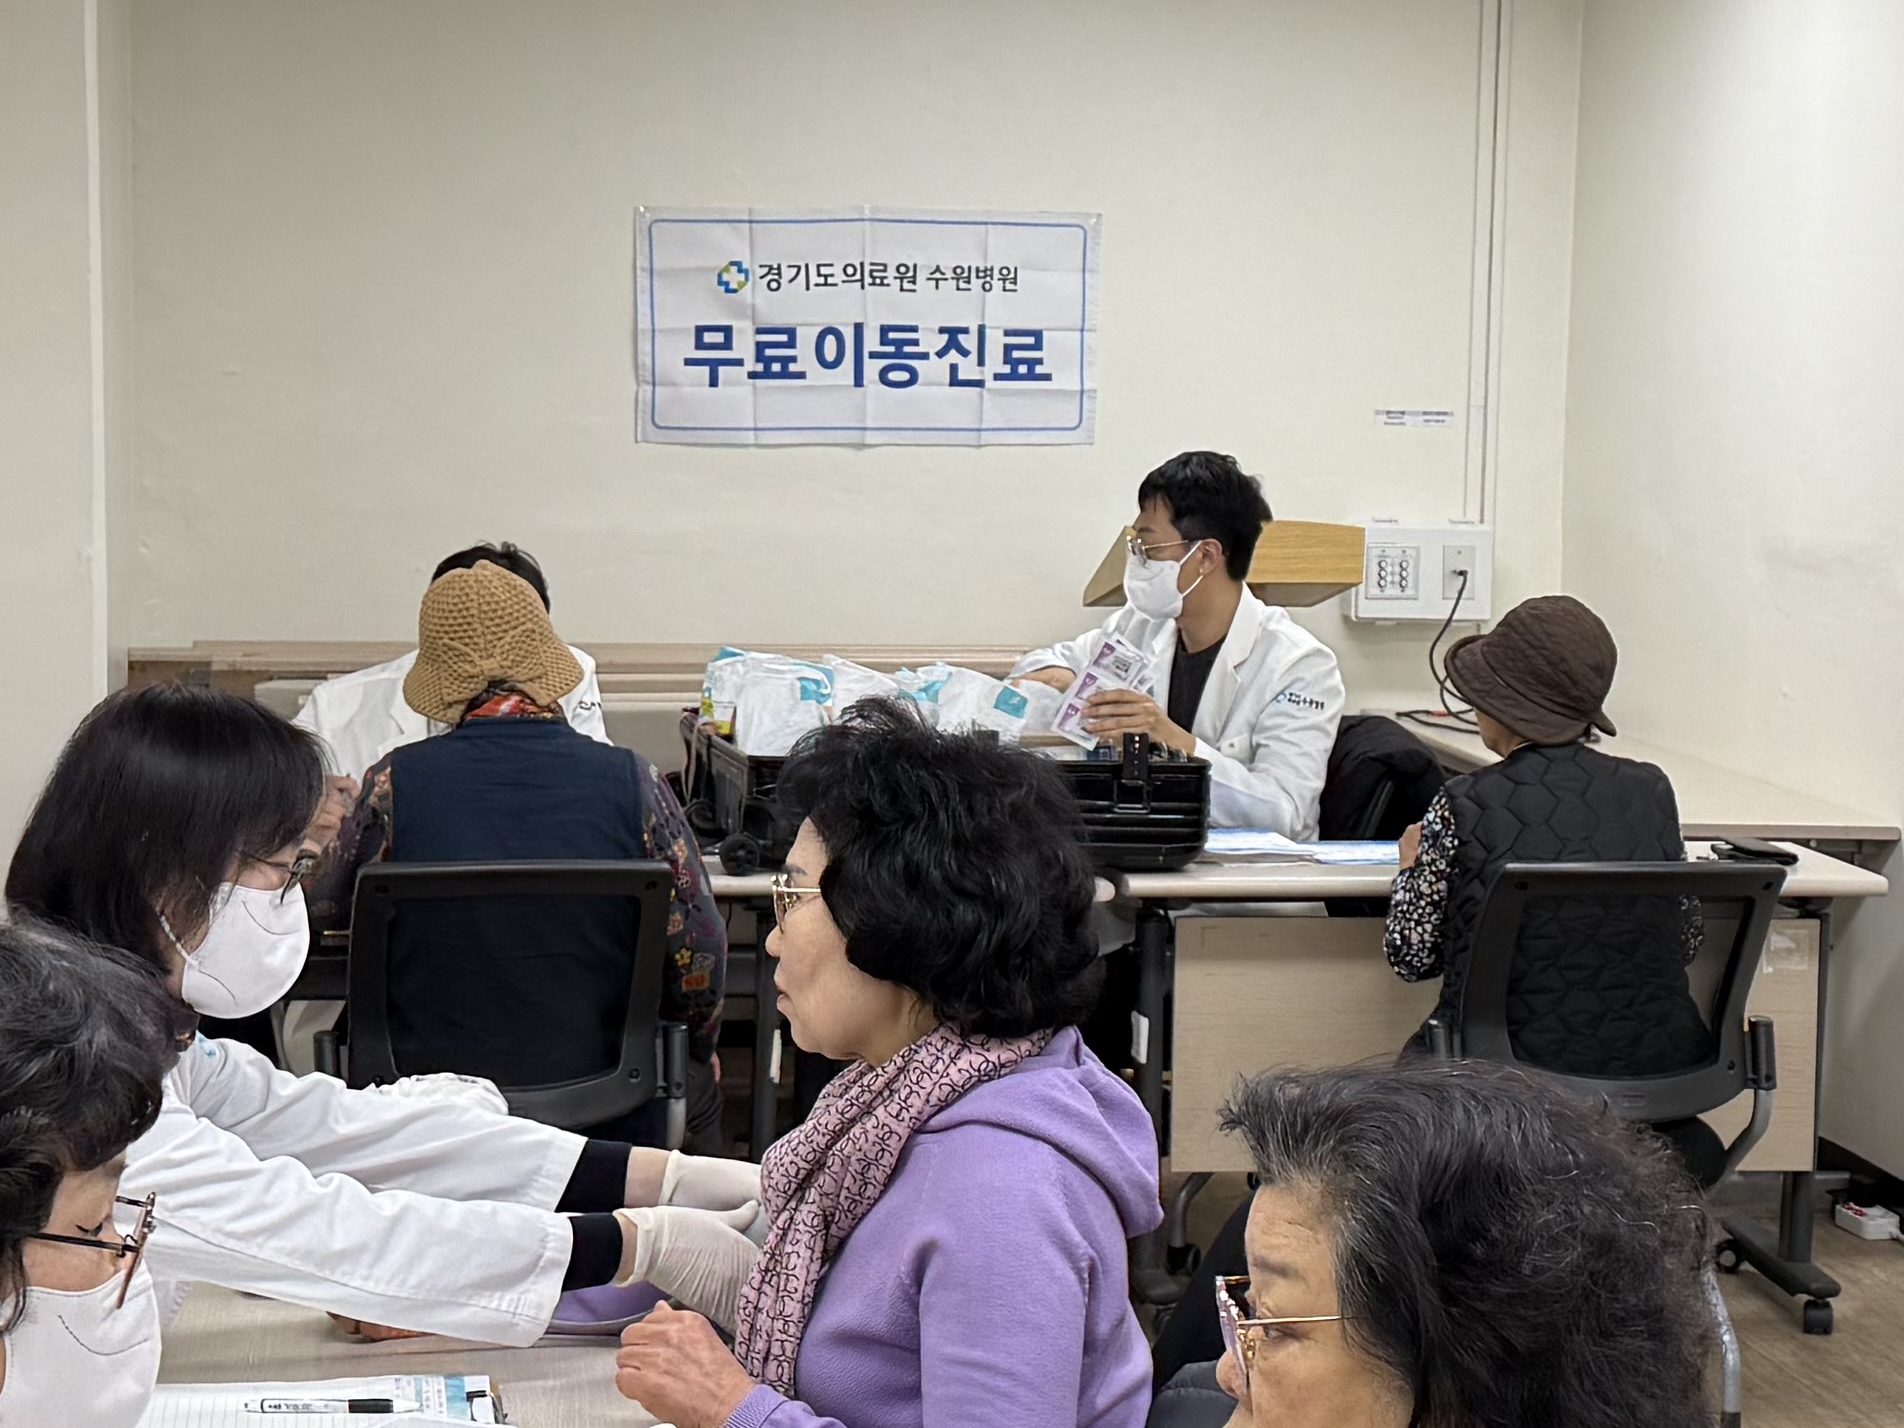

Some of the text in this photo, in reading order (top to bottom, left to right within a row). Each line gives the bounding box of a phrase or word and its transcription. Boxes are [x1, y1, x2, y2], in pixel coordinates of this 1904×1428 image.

[758, 261, 1020, 293] 경기도의료원 수원병원
[683, 321, 1053, 389] 무료이동진료
